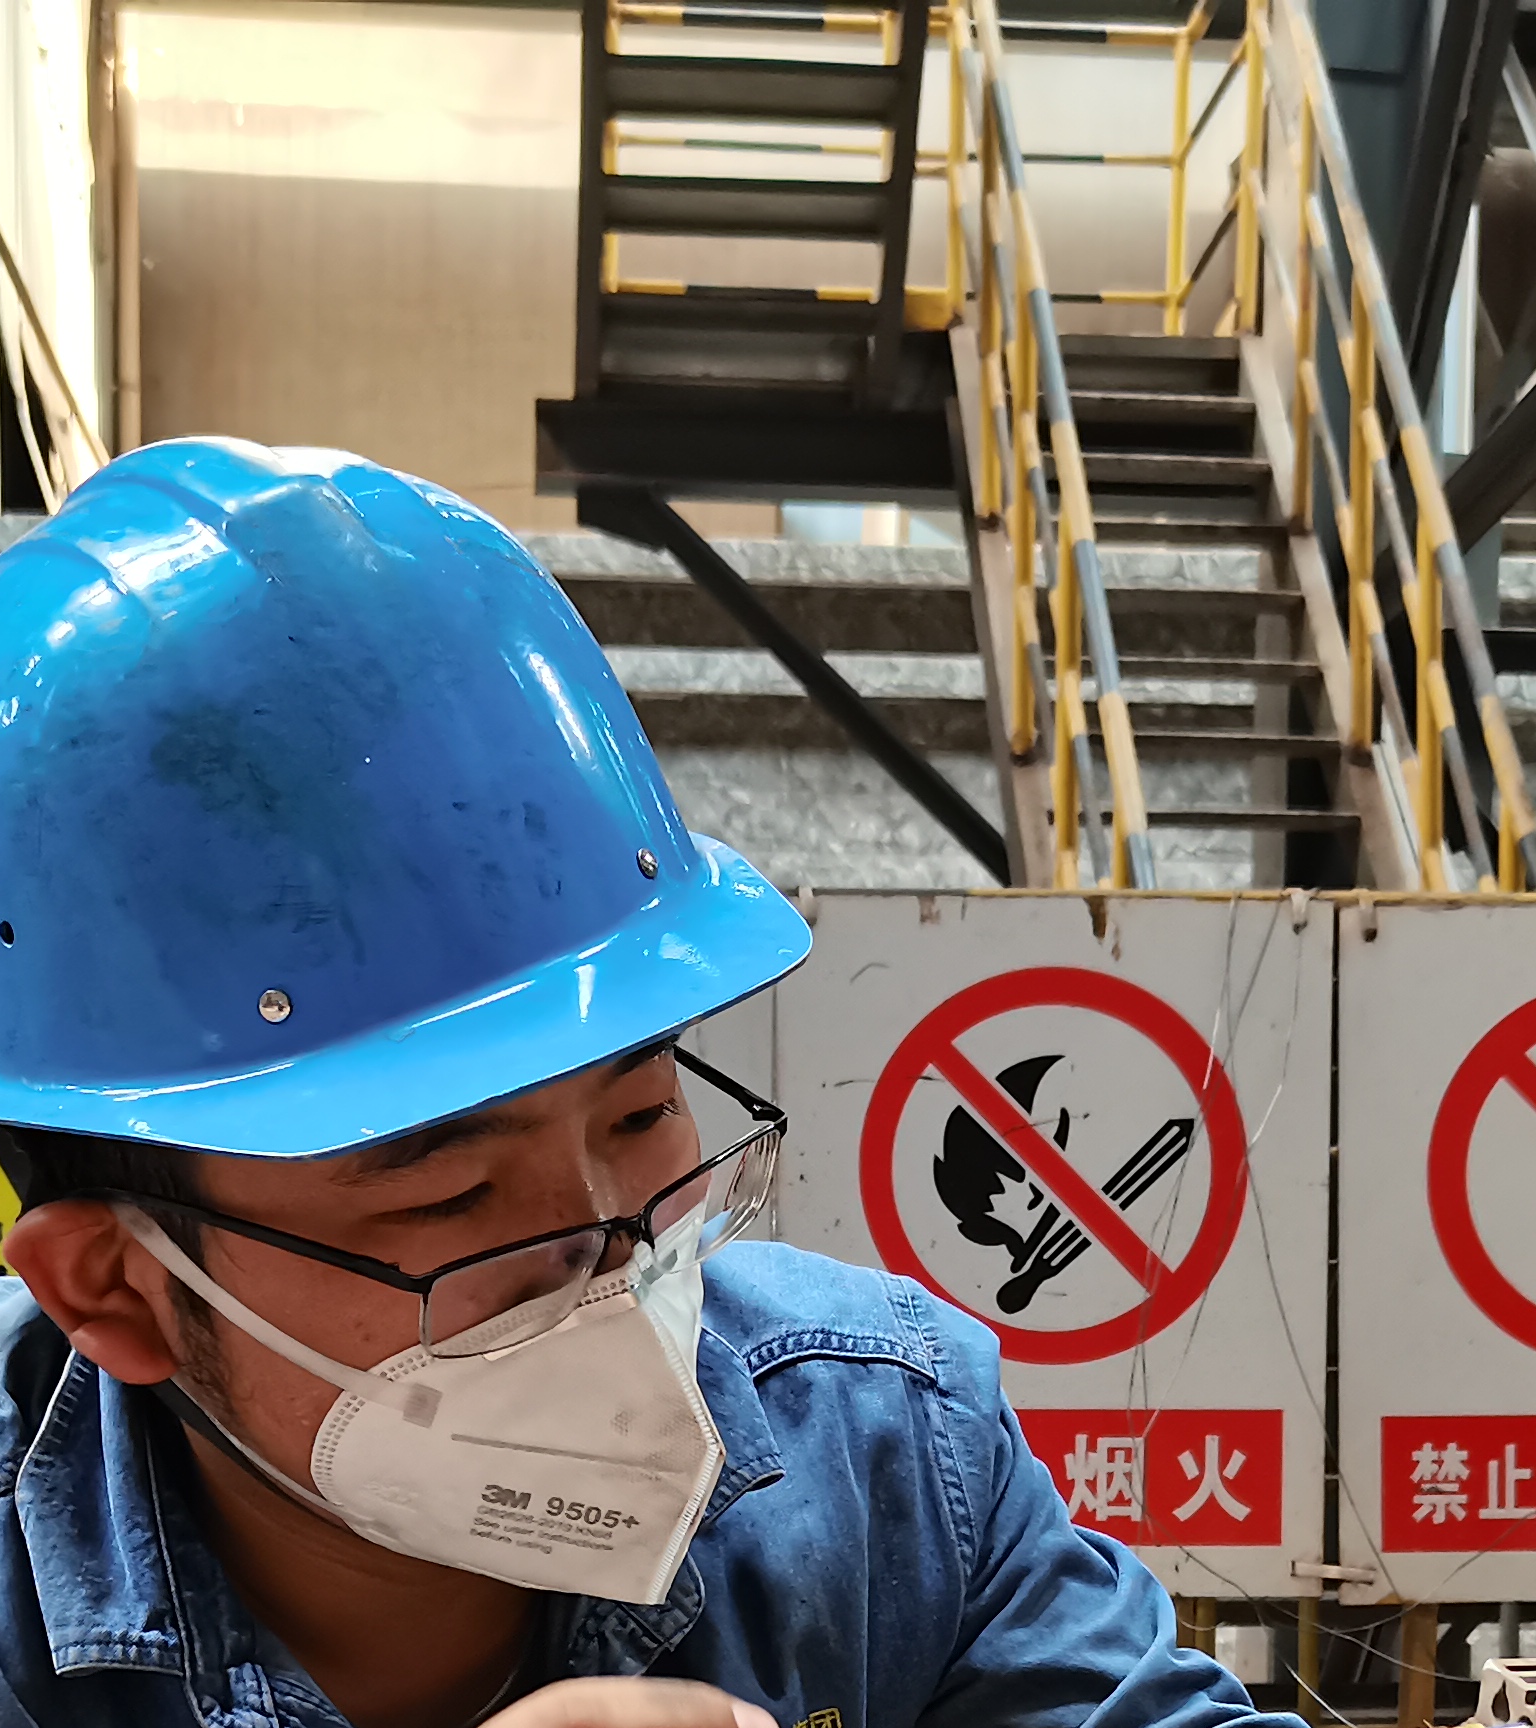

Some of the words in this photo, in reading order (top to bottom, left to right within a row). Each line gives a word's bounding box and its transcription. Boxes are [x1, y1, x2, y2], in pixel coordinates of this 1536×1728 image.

[481, 1484, 532, 1510] 3M
[545, 1496, 641, 1529] 9505+
[1064, 1433, 1252, 1522] 烟火
